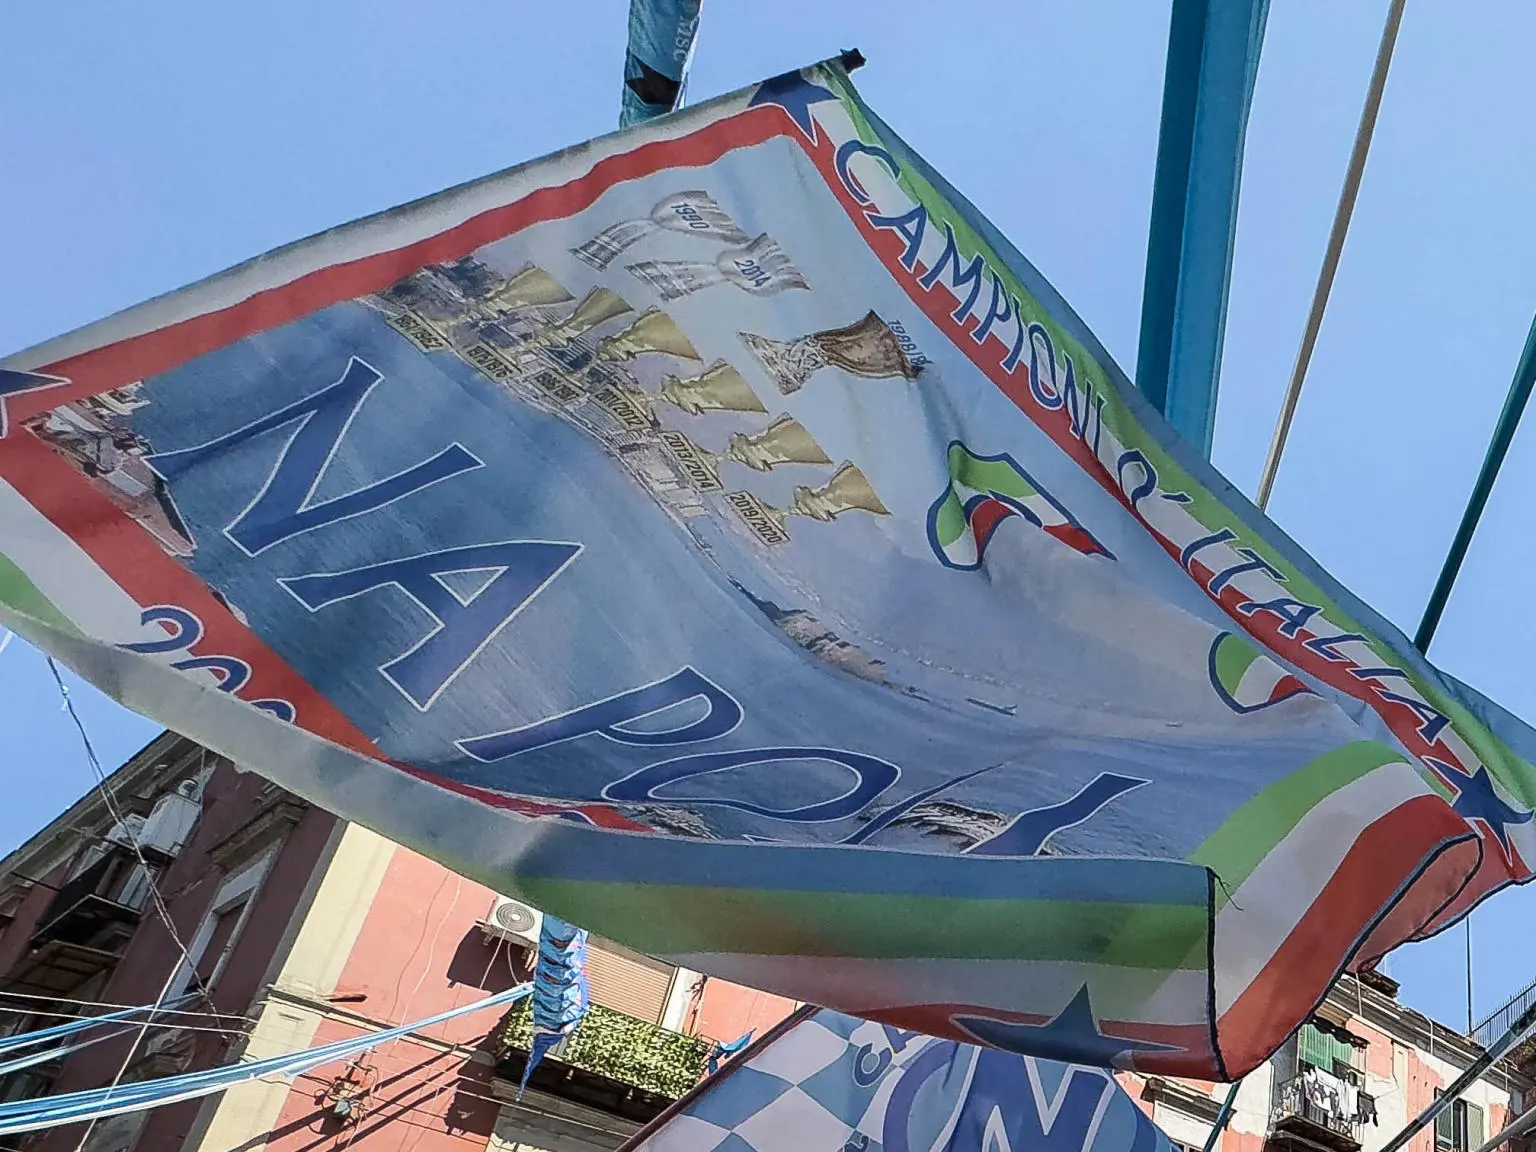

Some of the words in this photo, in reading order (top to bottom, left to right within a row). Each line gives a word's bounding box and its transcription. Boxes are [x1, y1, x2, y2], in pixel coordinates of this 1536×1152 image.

[670, 202, 709, 231] 1990
[734, 259, 772, 288] 2014
[834, 138, 1108, 465] CAMPIONI
[887, 318, 934, 368] 1988/8
[664, 433, 714, 490] 2013/2014
[730, 493, 783, 544] 2019/2020
